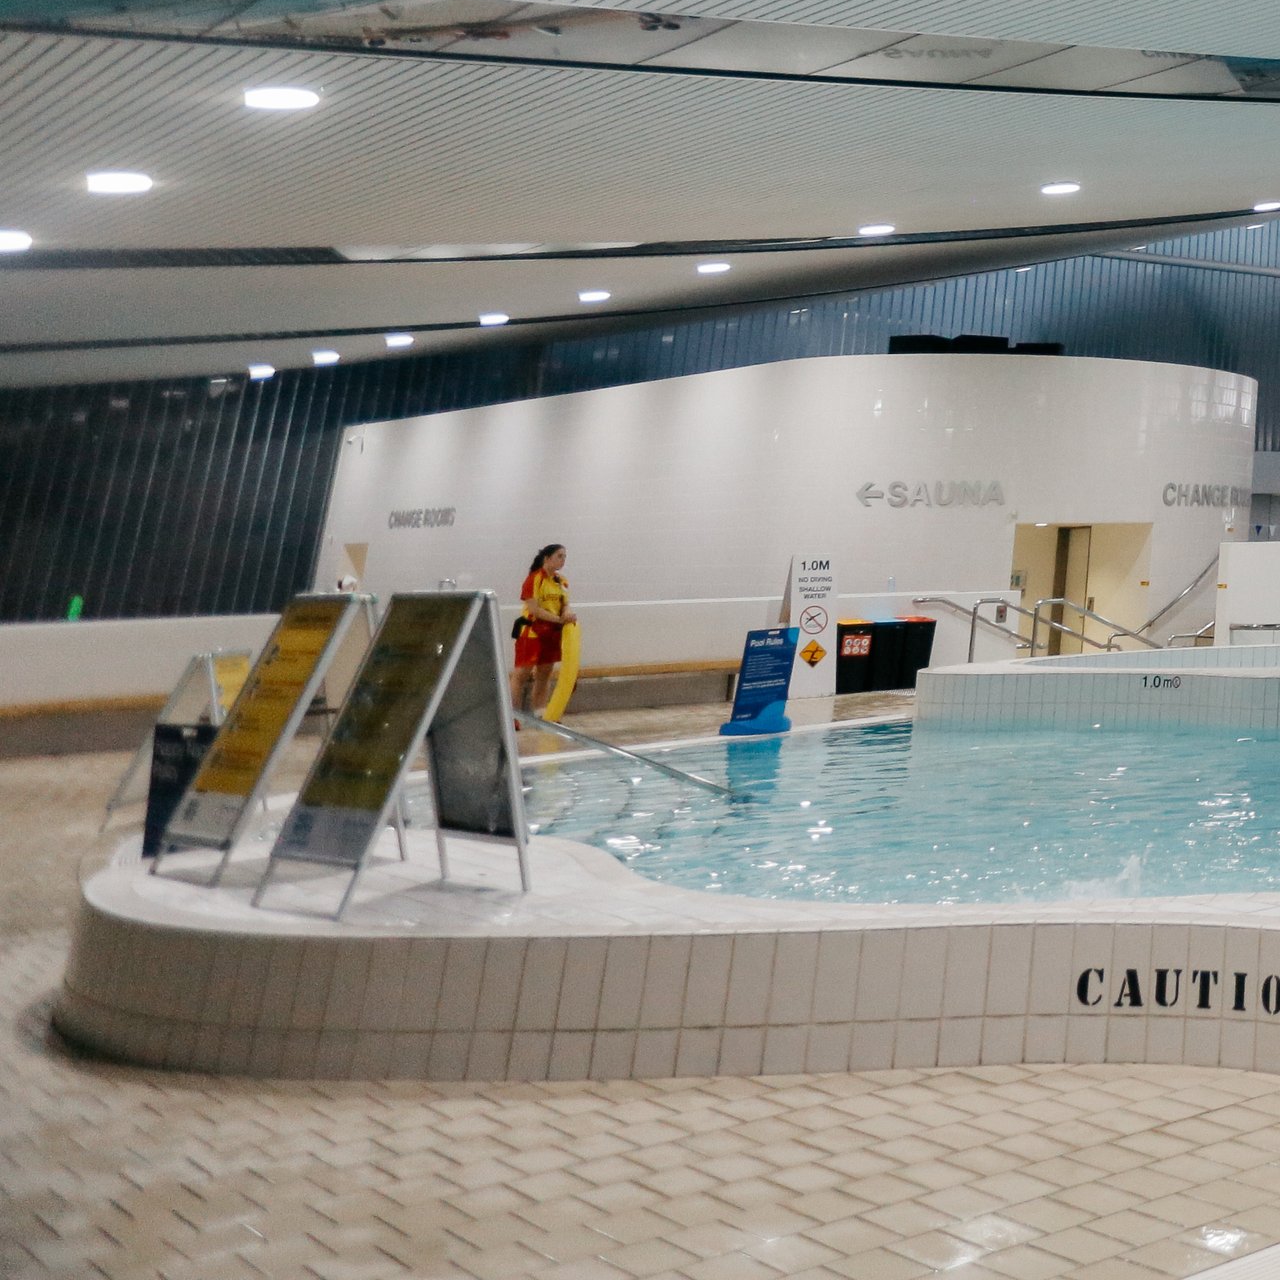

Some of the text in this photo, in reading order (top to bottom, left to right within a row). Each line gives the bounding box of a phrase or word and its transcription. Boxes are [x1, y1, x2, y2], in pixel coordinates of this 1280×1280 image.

[887, 480, 1005, 508] SAUNA
[1162, 482, 1229, 508] CHANGE
[800, 559, 830, 571] 1.0M
[750, 638, 784, 647] Pool Rules
